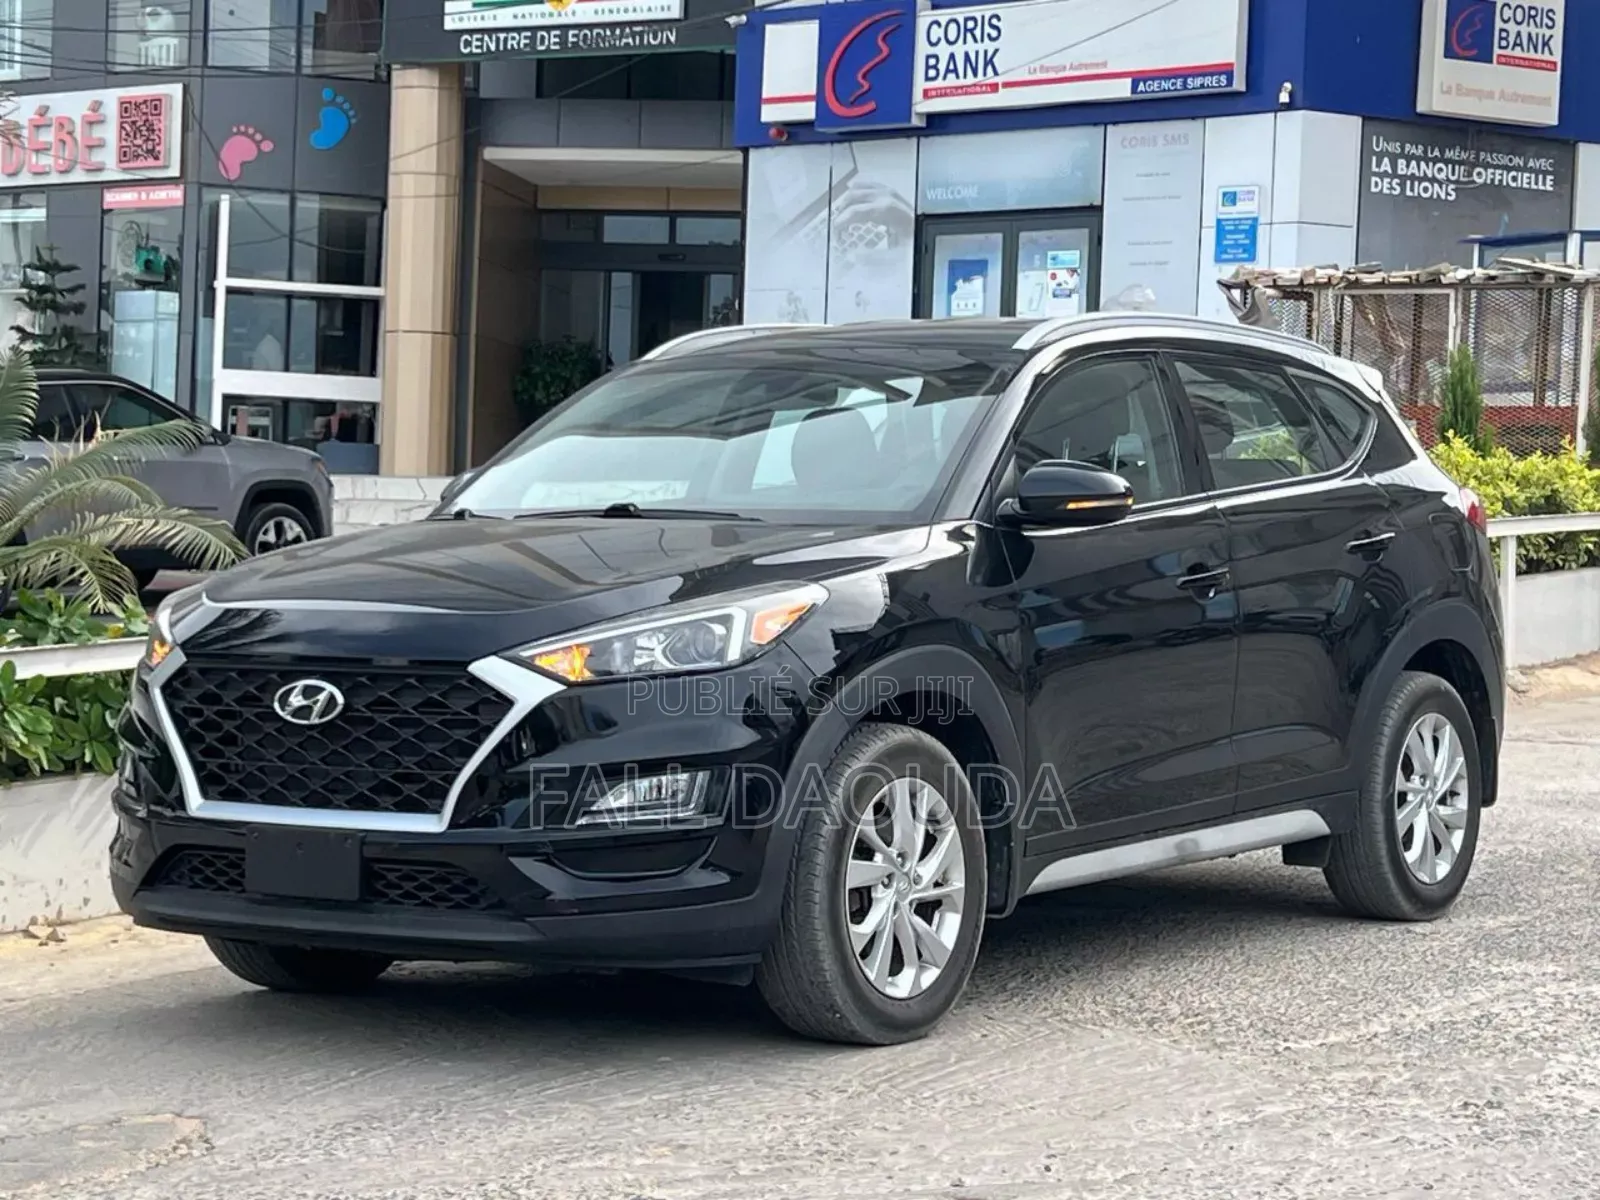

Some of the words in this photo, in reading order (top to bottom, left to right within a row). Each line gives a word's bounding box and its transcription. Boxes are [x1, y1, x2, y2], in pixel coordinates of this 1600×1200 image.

[513, 9, 576, 20] NATIONALE
[1499, 3, 1556, 30] CORIS
[460, 31, 531, 53] CENTRE
[536, 30, 561, 50] DE
[568, 26, 676, 48] FORMATION
[926, 13, 1001, 47] CORIS
[1497, 28, 1554, 56] BANK
[924, 49, 999, 82] BANK
[1498, 56, 1556, 71] INTERNATIONAL
[1137, 77, 1183, 92] AGENCE
[1186, 74, 1227, 89] SIPRES
[1405, 143, 1424, 157] PAR
[1428, 146, 1440, 159] LA
[1444, 145, 1475, 162] MÊME
[1479, 151, 1524, 167] PASSION
[1527, 157, 1554, 171] AVEC
[1371, 156, 1392, 174] LA
[1473, 167, 1554, 191] OFFICIELLE
[926, 185, 978, 200] WELCOME
[1370, 176, 1400, 195] DES
[1405, 180, 1456, 201] LIONS
